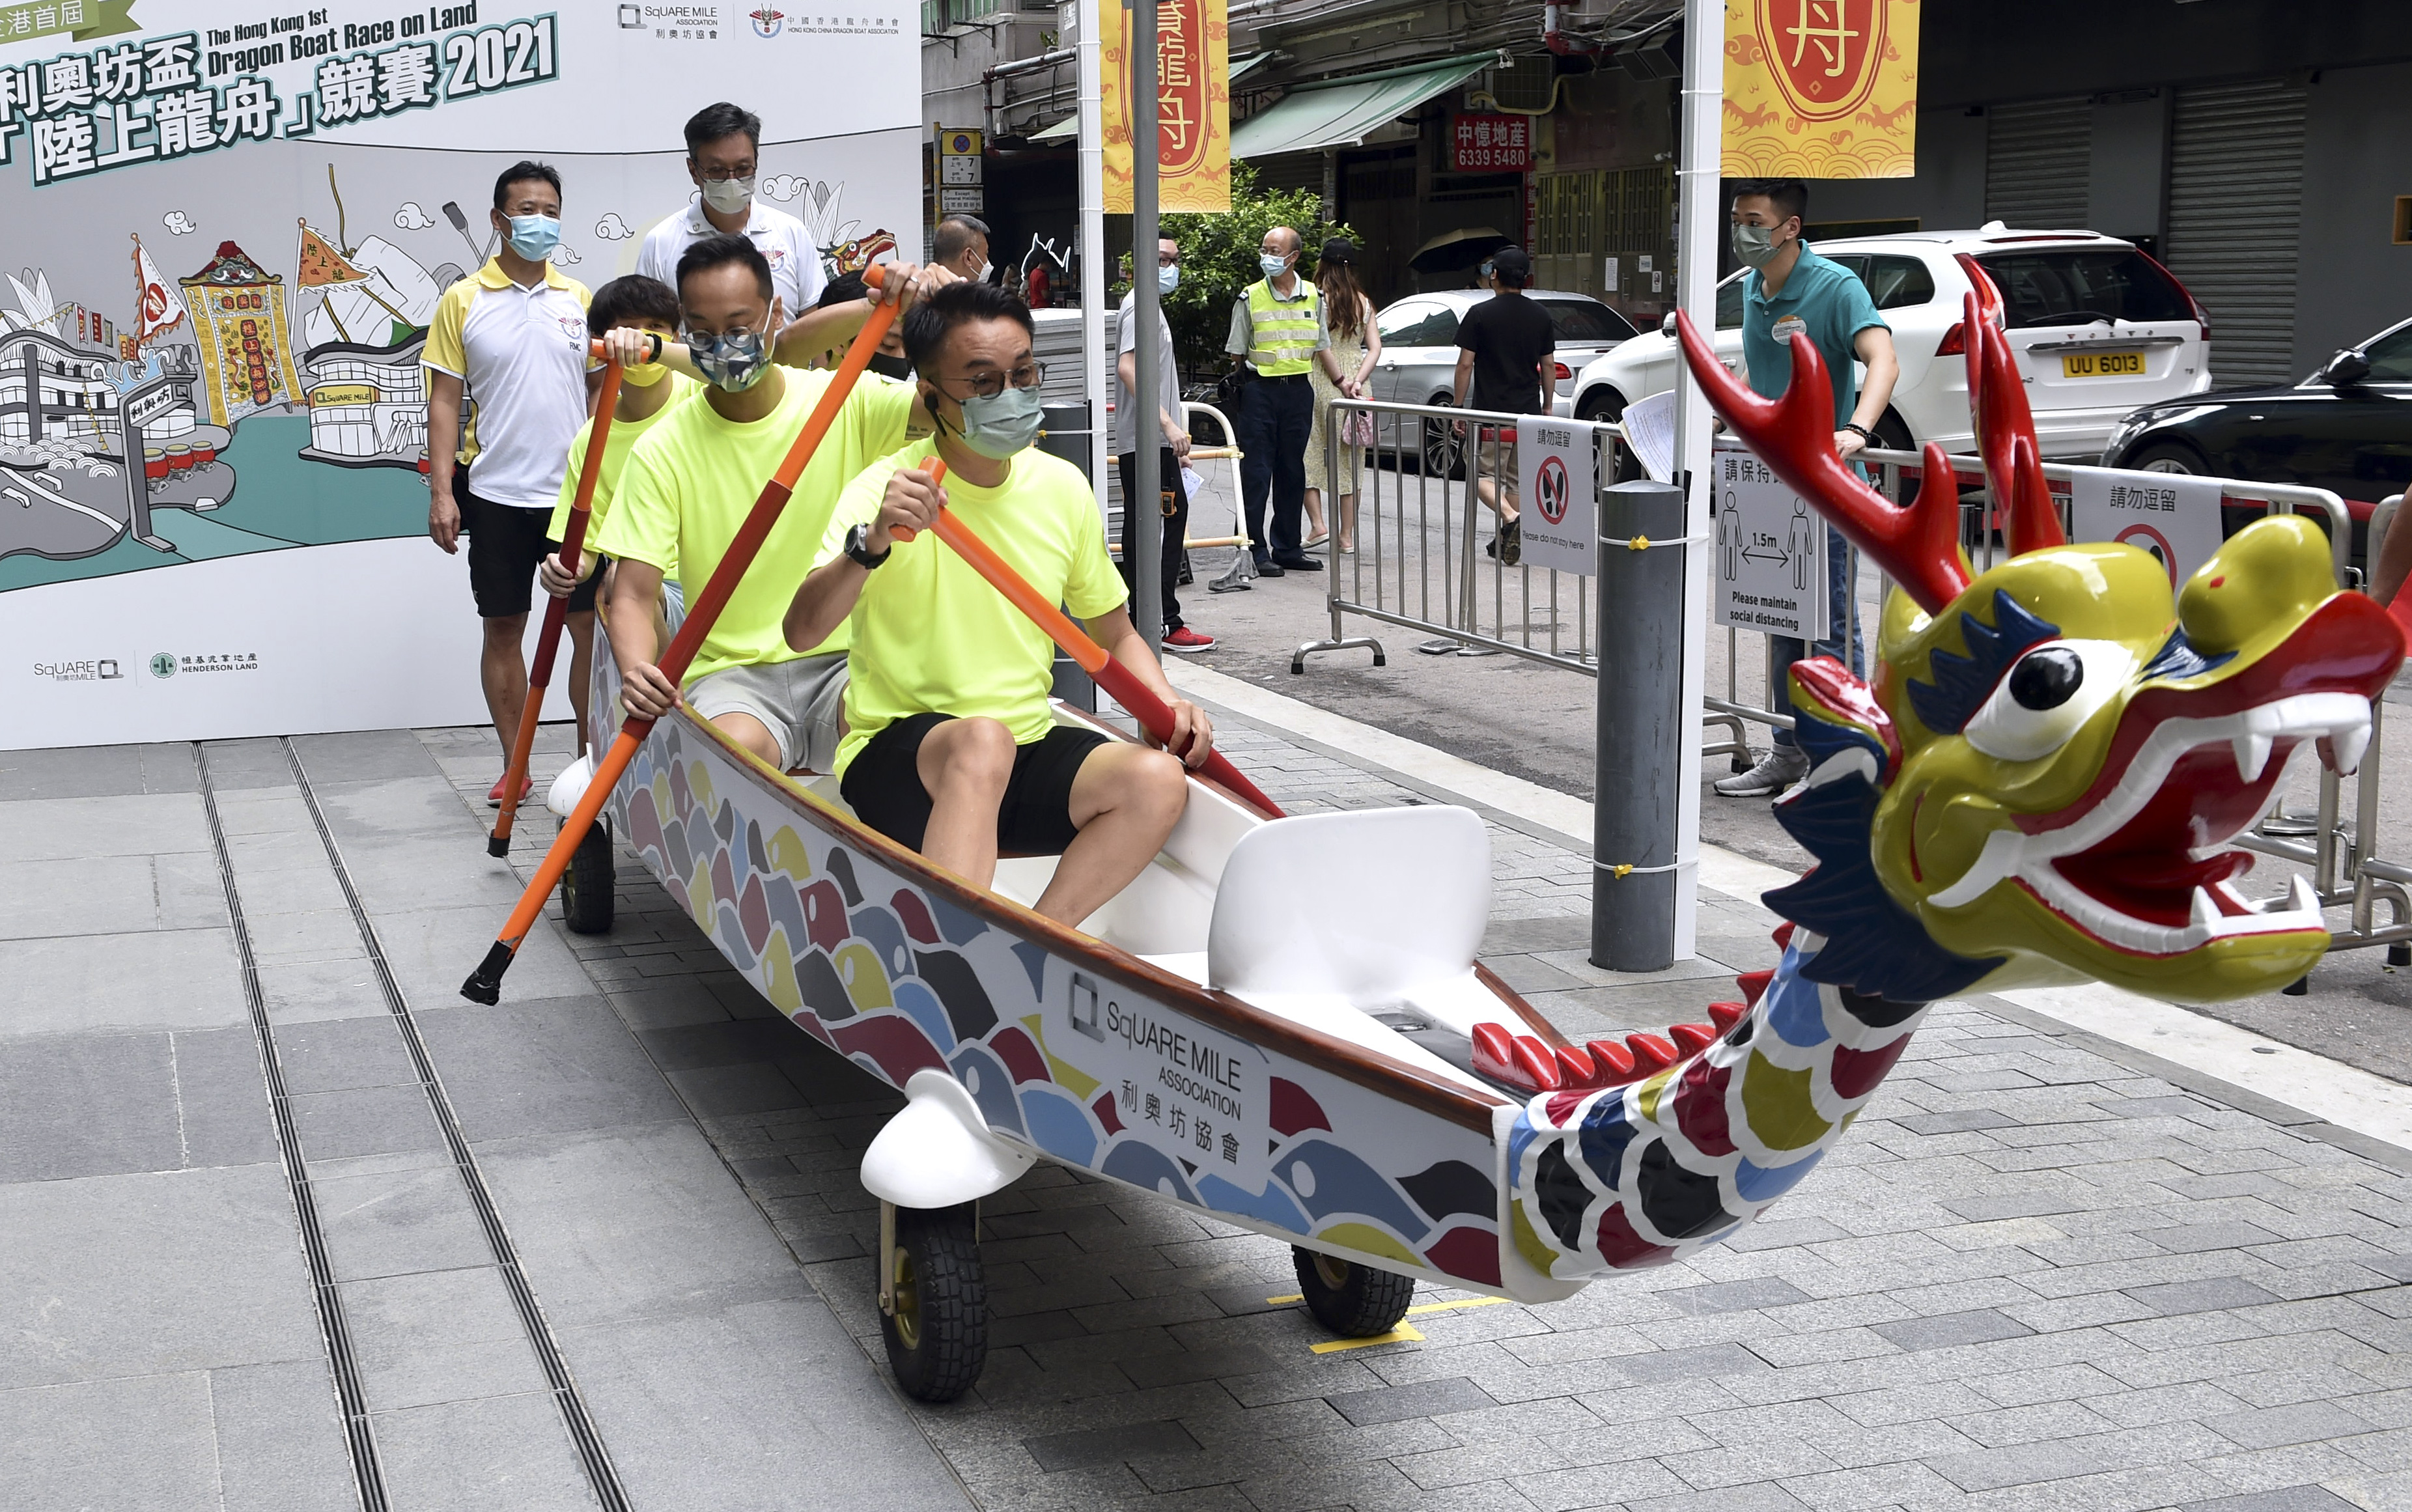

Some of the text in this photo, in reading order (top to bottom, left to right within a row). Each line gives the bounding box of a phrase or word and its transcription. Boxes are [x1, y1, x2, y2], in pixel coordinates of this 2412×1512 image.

[0, 1, 83, 36] 港首屆
[692, 7, 718, 17] MILE
[207, 8, 328, 47] The Hong Kong 1st
[656, 29, 718, 39] 利奧坊協會
[208, 0, 477, 77] Dragon Boat Race on Land
[446, 18, 553, 96] 2021
[968, 158, 974, 167] 7
[1459, 149, 1525, 165] 6339 5480
[968, 173, 974, 182] 7
[2067, 329, 2153, 339] VOLVO
[2069, 356, 2139, 374] UU 6013
[1537, 428, 1571, 448] 請勿逗留
[2110, 486, 2176, 512] 請勿逗留
[1540, 533, 1549, 542] do
[1569, 539, 1585, 550] here
[1752, 532, 1777, 548] 1.5m
[1732, 591, 1797, 611] Please maintain
[1730, 610, 1799, 632] social distancing
[182, 664, 233, 673] HENDERSON
[1191, 1041, 1241, 1093] MILE
[1158, 1066, 1241, 1121] ASSOCIATION
[1121, 1079, 1240, 1165] 利奧坊協會
